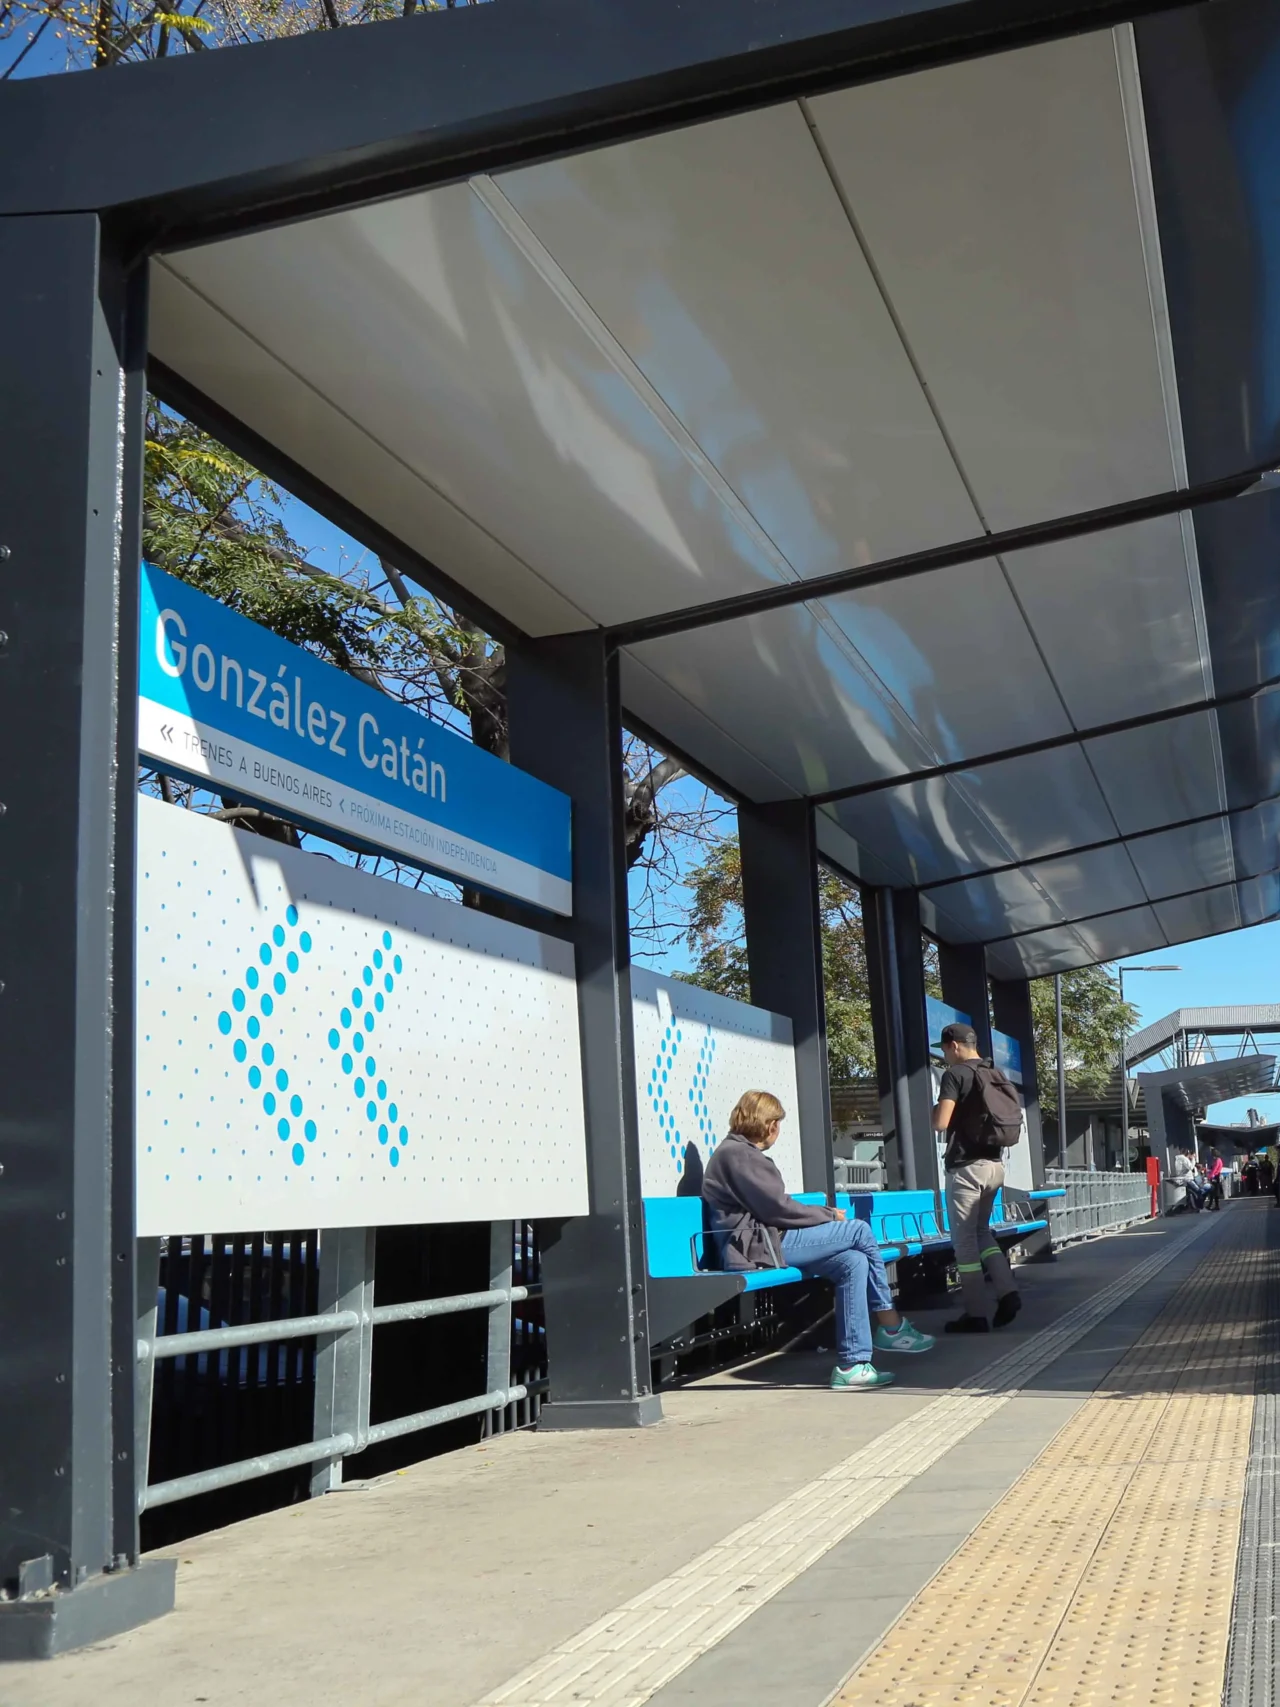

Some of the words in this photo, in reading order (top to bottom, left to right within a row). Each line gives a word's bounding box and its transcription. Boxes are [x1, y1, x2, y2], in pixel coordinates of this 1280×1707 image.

[155, 607, 347, 757] González
[358, 711, 448, 803] Catán
[183, 731, 233, 768] TRENES
[238, 756, 248, 775] A
[253, 761, 300, 795] BUENOS
[302, 783, 332, 808] AIRES
[350, 802, 392, 832] PRÓXIMA
[393, 819, 435, 848] ESTACIÓN
[436, 836, 498, 873] INDEPENDENCIA
